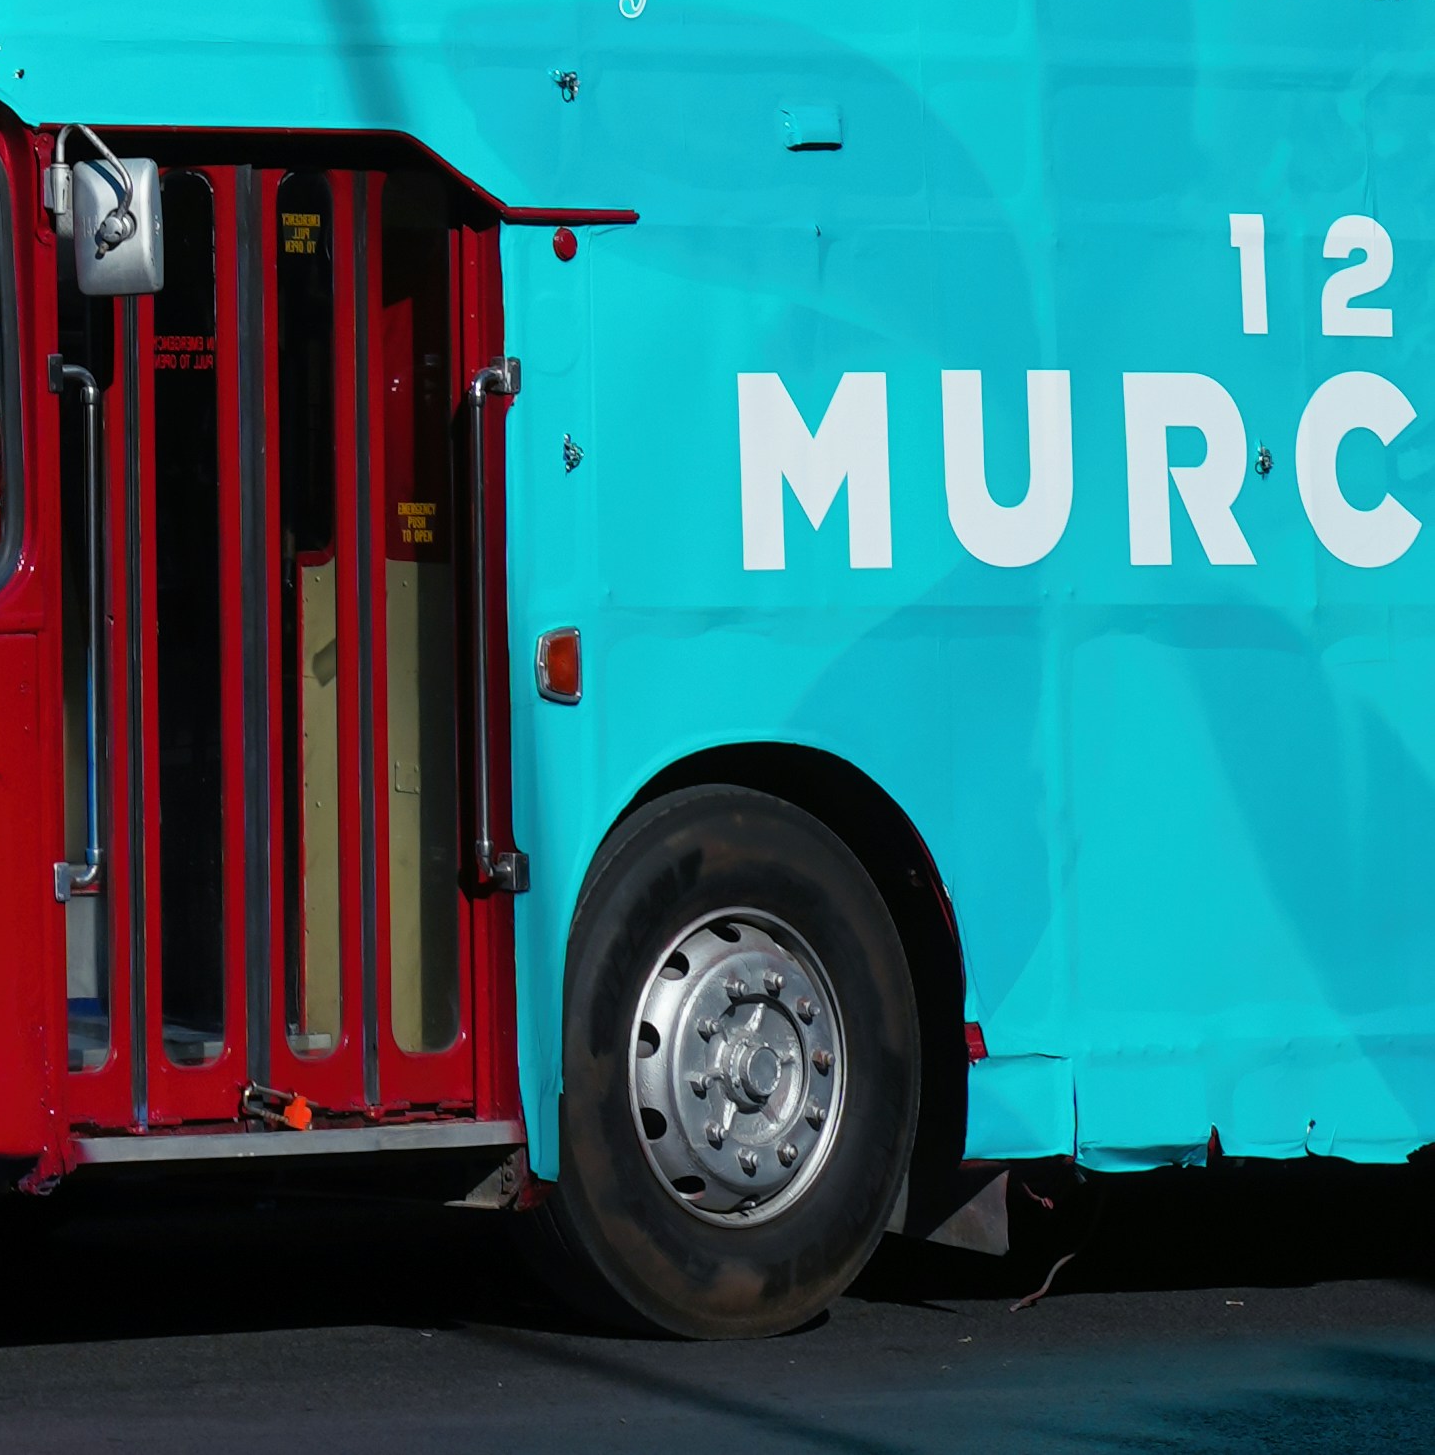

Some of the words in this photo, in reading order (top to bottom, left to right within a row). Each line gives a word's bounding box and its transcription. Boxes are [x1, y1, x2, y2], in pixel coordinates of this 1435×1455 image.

[1228, 212, 1394, 338] 12
[736, 368, 1423, 572] MURC
[397, 502, 437, 516] EMERGENCY
[401, 529, 412, 543] TO
[414, 529, 433, 543] OPEN
